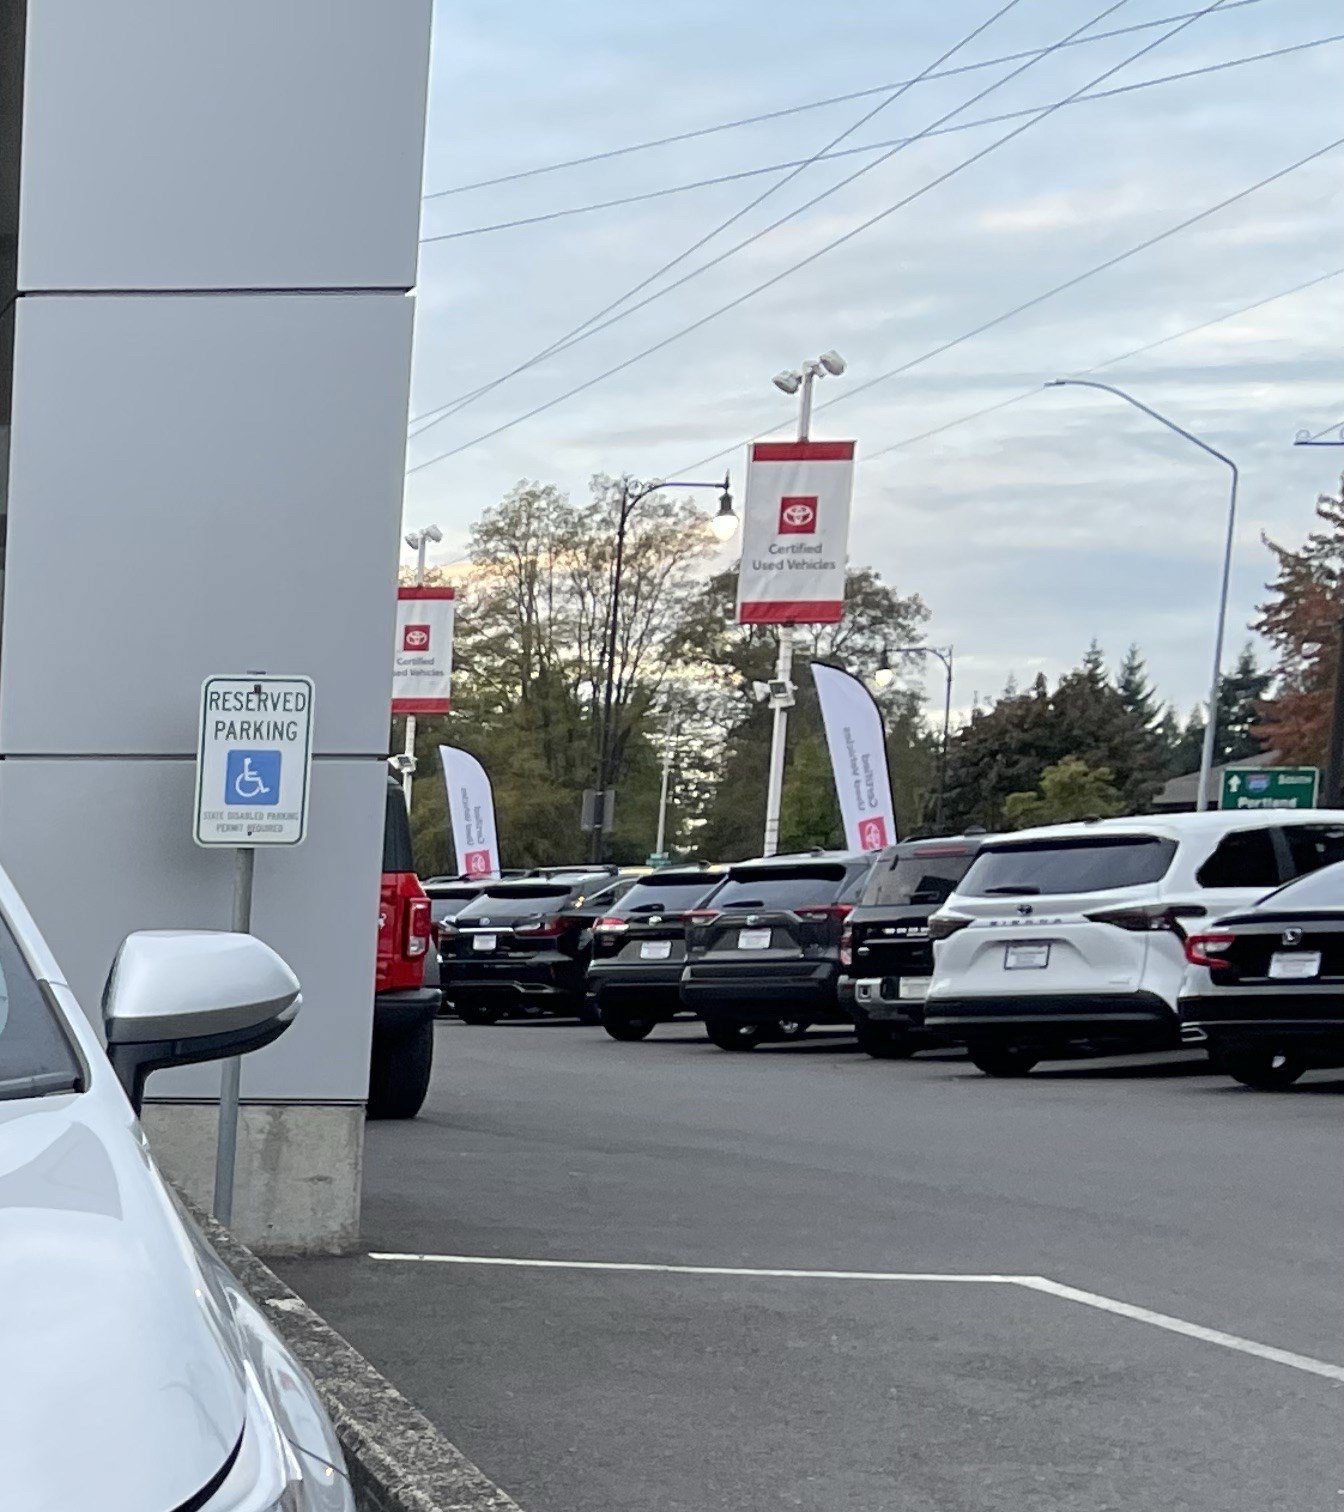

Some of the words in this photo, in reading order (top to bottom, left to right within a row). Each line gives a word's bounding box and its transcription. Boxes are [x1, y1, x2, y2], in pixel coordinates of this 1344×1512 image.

[769, 543, 823, 555] Certified
[752, 559, 784, 571] Used
[787, 558, 836, 571] Vehicles
[209, 691, 306, 712] RESERVED
[214, 720, 298, 741] PARKING
